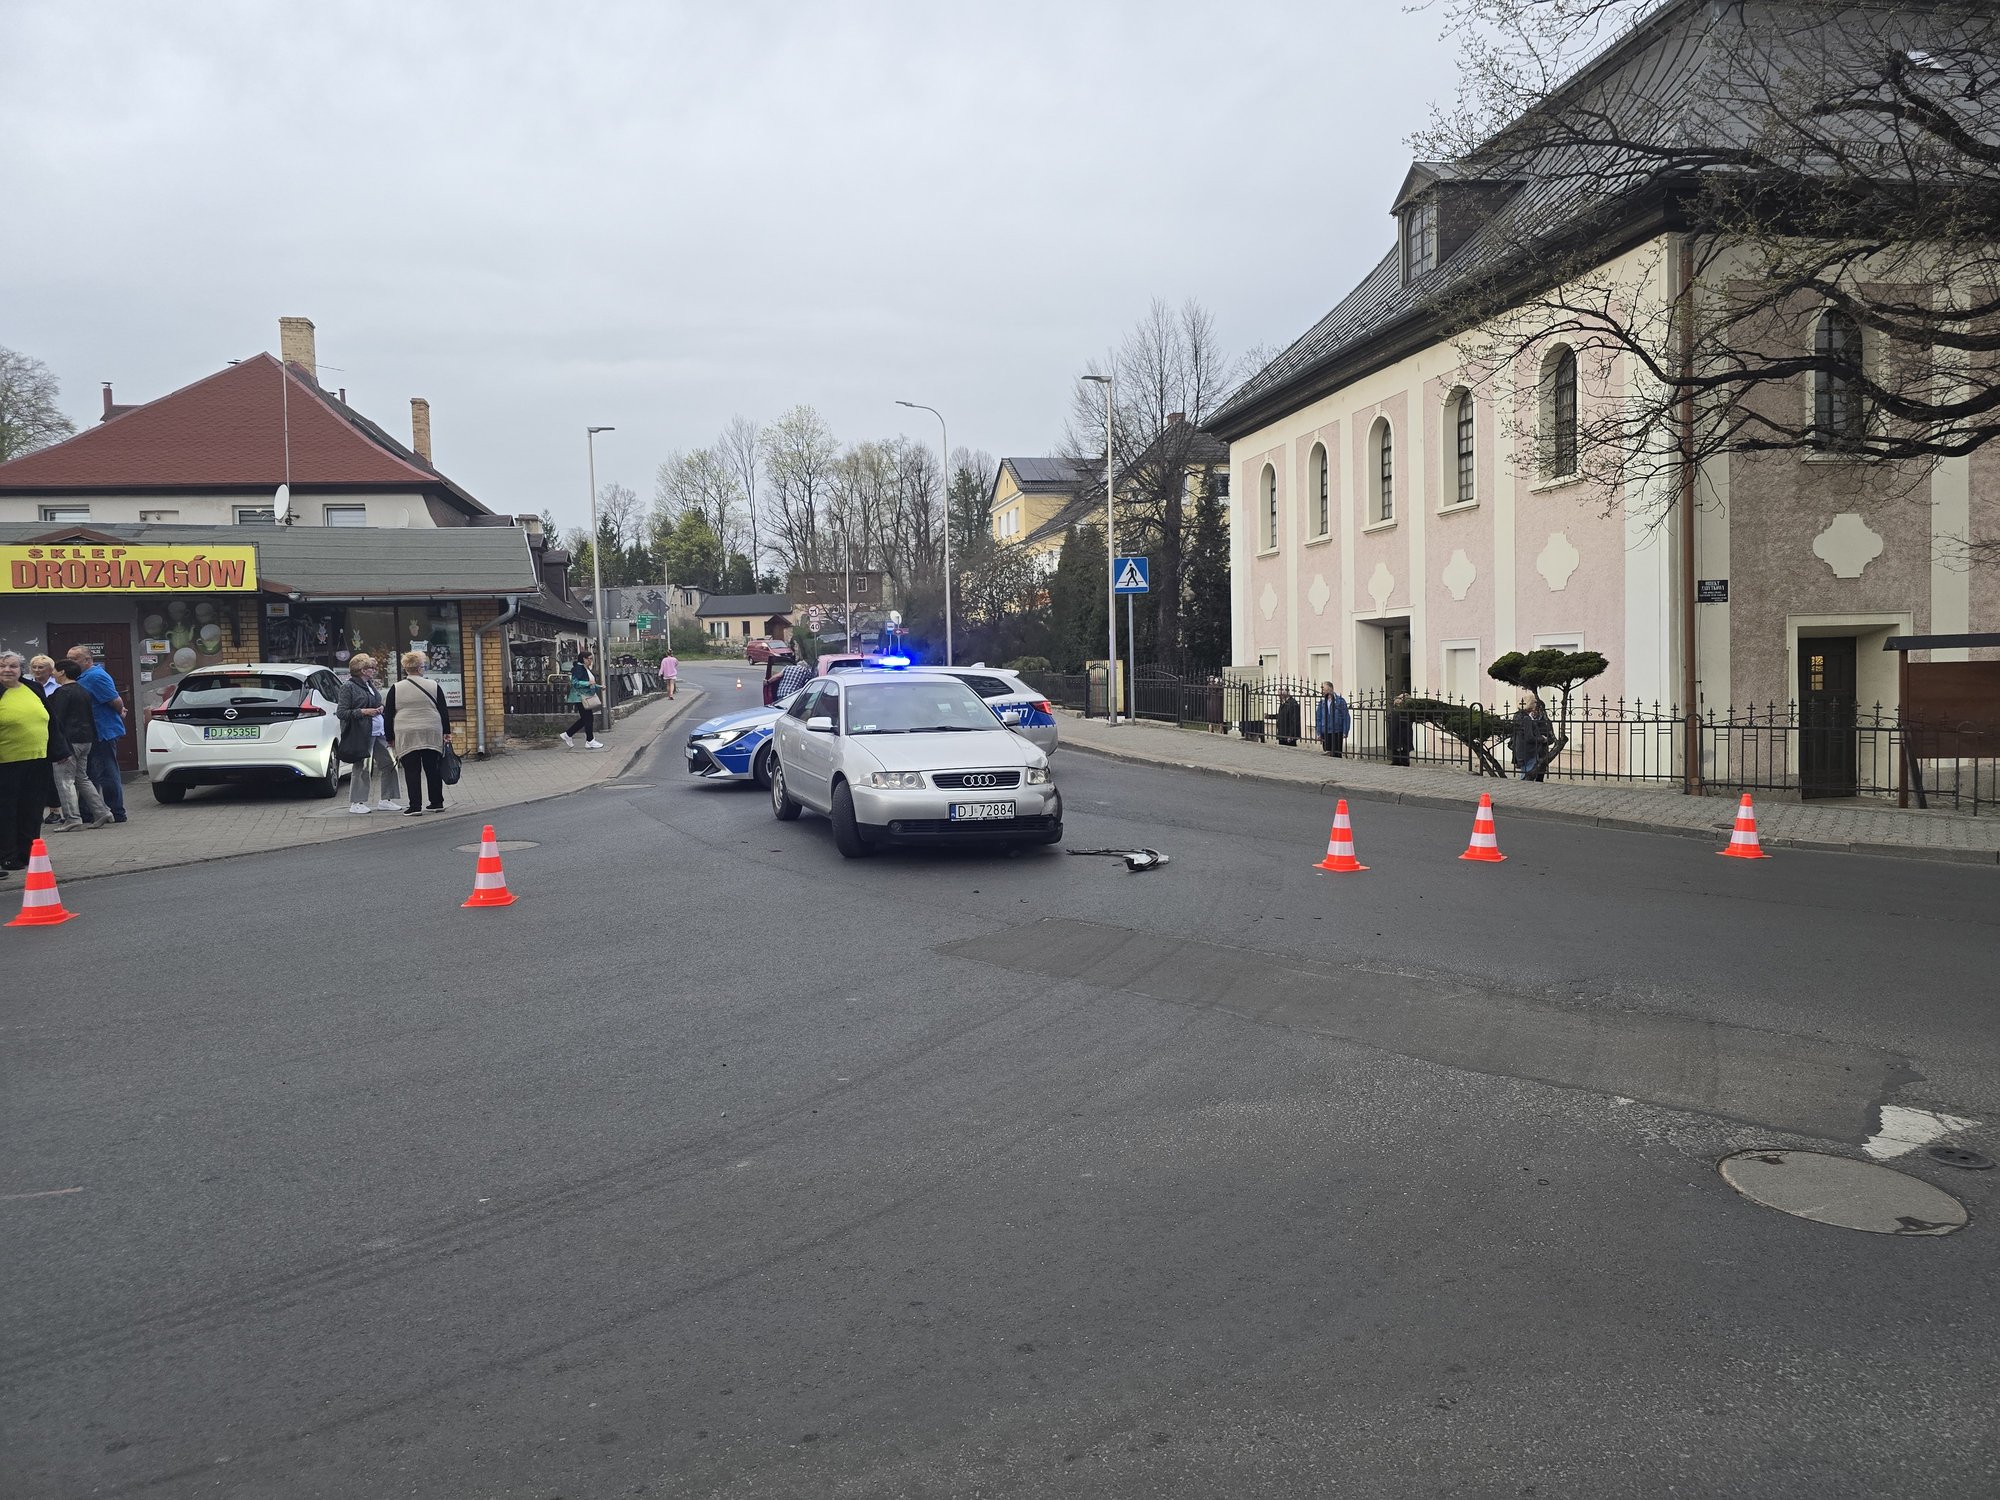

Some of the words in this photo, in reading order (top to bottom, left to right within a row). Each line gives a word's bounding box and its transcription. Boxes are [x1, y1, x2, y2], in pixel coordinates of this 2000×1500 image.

[28, 548, 127, 559] SKLEP
[11, 555, 246, 589] DROBIAZGÓW
[210, 728, 223, 737] DJ
[226, 727, 257, 737] 9535E
[958, 805, 974, 818] DJ
[979, 803, 1014, 817] 72884
